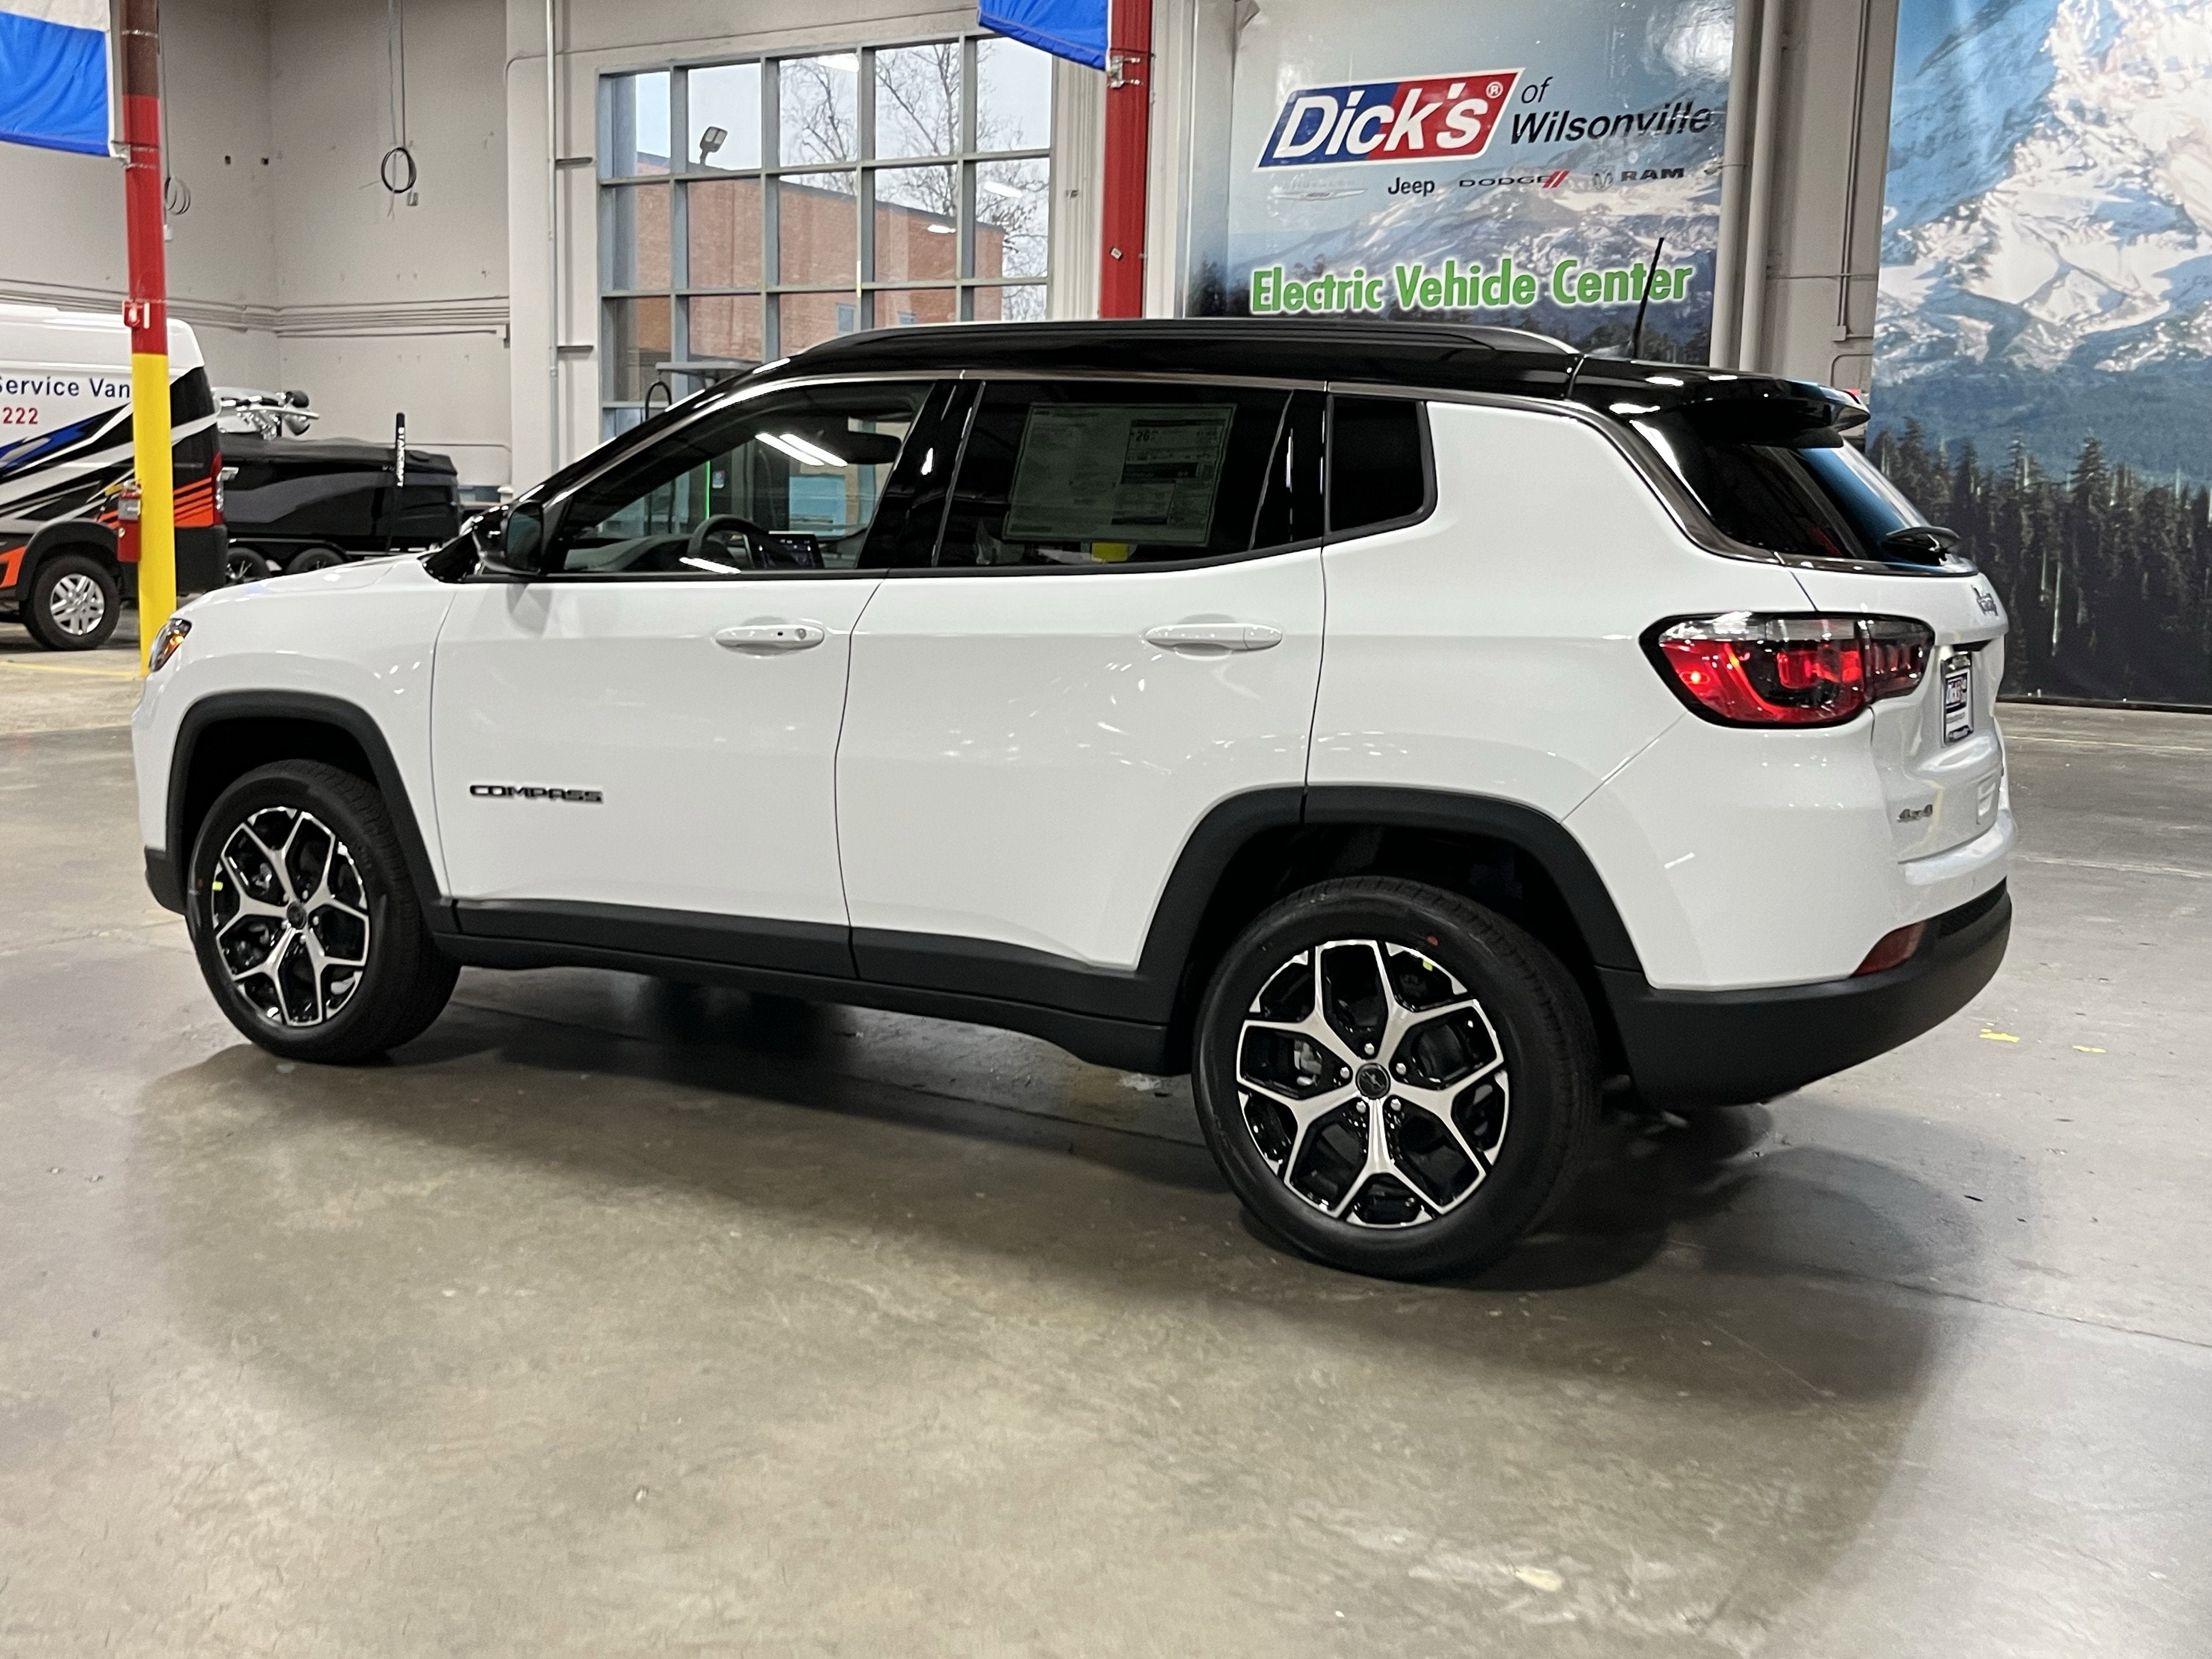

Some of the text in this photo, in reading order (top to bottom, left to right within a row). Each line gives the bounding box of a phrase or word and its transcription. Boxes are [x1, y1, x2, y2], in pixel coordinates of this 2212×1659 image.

[1521, 76, 1553, 104] of
[1511, 100, 1711, 144] Wilsonville
[1459, 175, 1551, 187] DODGE
[1620, 167, 1685, 182] RAM
[1387, 177, 1435, 196] Jeep
[1252, 258, 1693, 312] Electric Vehicle Center
[0, 376, 131, 398] ervice Van
[3, 407, 38, 425] 222
[470, 785, 602, 803] COMPASS
